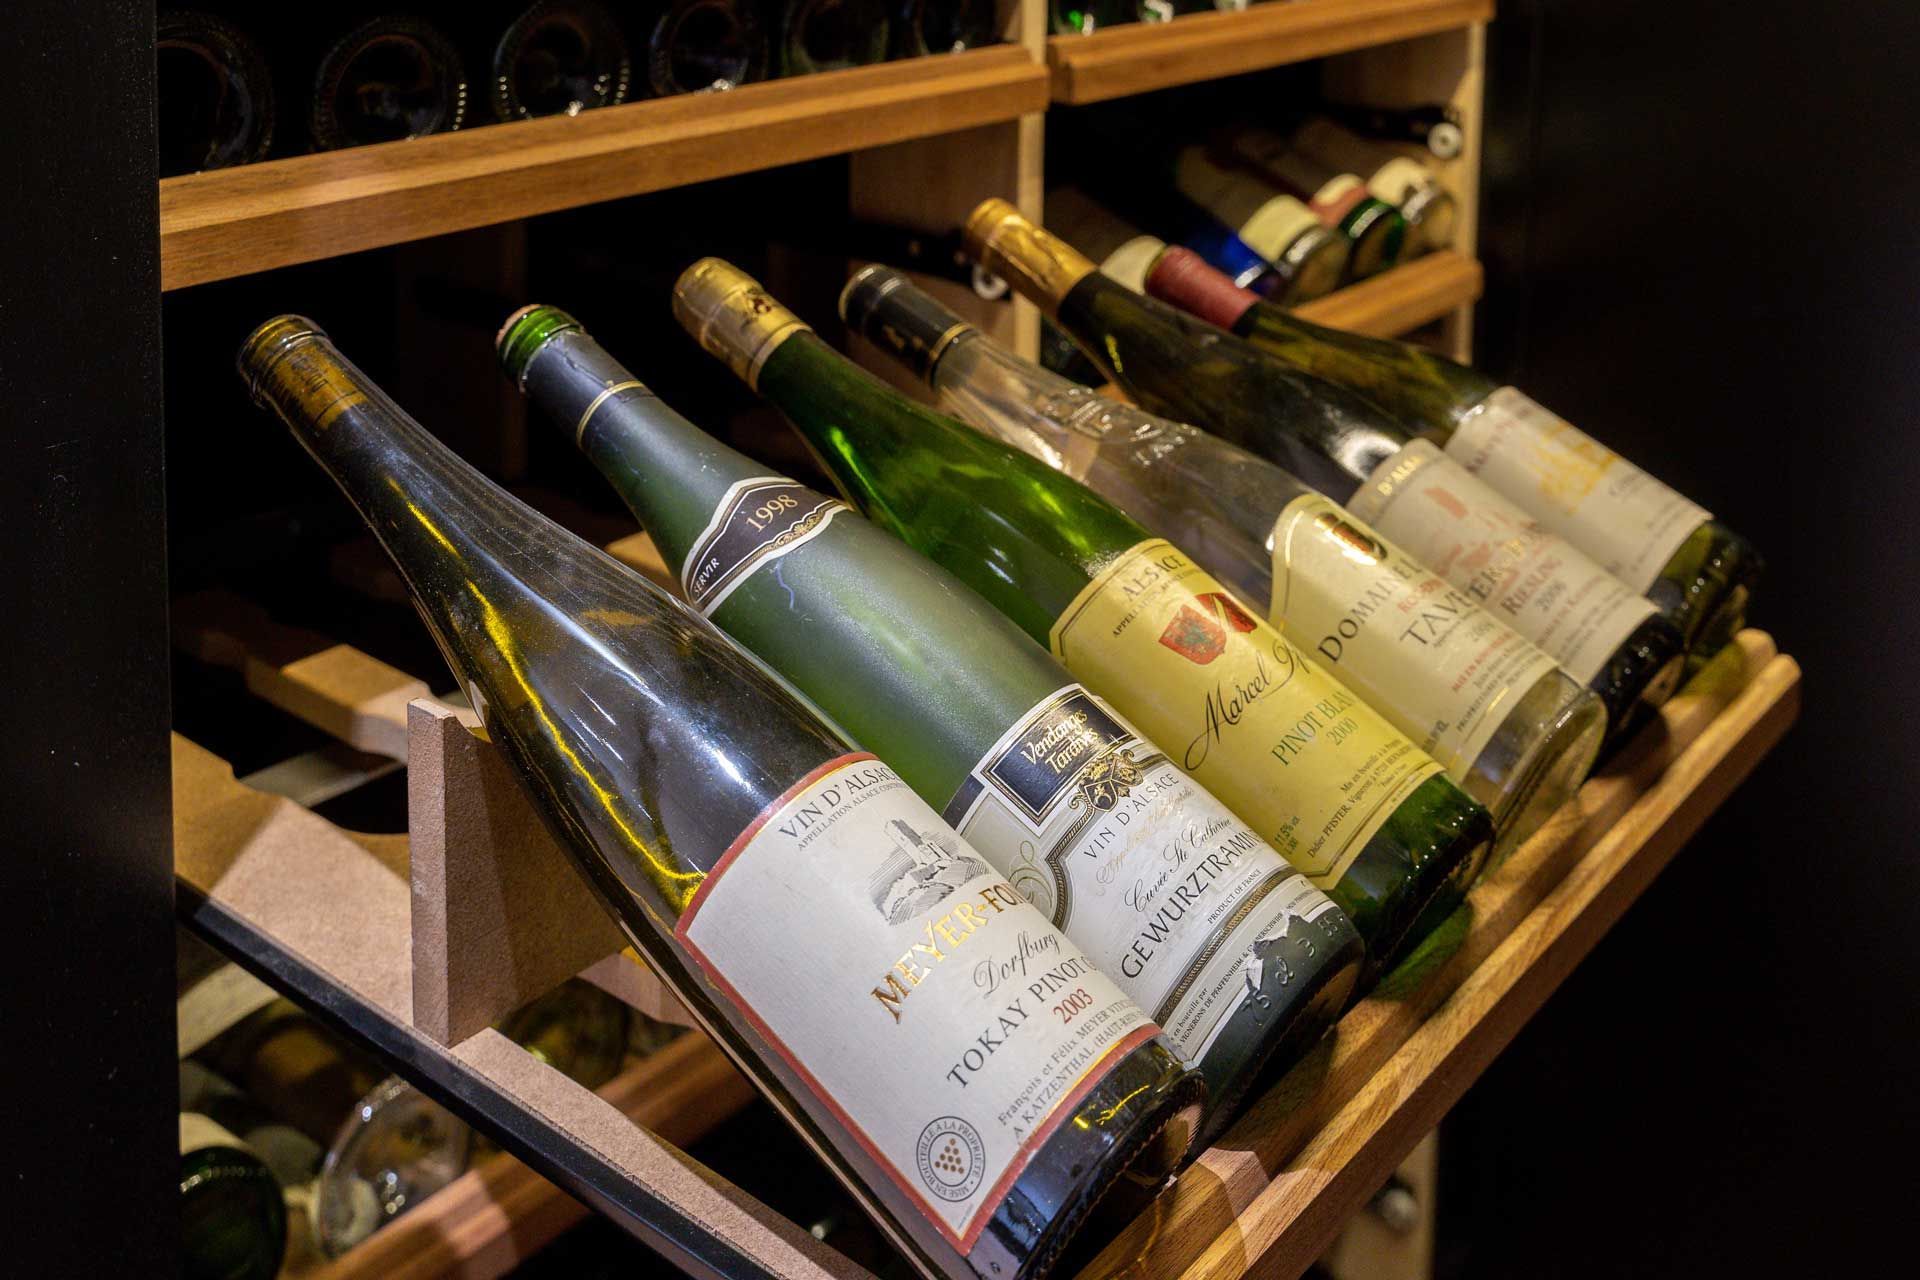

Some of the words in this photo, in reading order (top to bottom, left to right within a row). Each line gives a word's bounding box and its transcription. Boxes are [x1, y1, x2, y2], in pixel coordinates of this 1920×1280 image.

[746, 494, 799, 533] 1998
[1020, 709, 1088, 765] Vendanges
[1185, 651, 1271, 771] Marcel
[1270, 711, 1325, 767] PINOT
[1326, 716, 1359, 746] 2000
[1044, 727, 1100, 775] Tardives
[778, 801, 824, 839] VIN
[797, 803, 854, 851] APPELLATION
[852, 788, 882, 807] ALSACE
[1083, 826, 1116, 860] VIN
[1115, 773, 1180, 827] D'ALSACE
[1307, 836, 1325, 858] Didier
[1121, 830, 1263, 979] GEWURZTRAMIN
[1124, 878, 1169, 912] Cuvée
[1207, 893, 1237, 925] PRODUCT
[1234, 885, 1246, 896] OF
[1242, 868, 1263, 888] FRANCE
[972, 929, 1062, 1000] Dorfburg
[946, 998, 1030, 1089] TOKAY
[1027, 957, 1086, 1004] PINOT
[1052, 988, 1095, 1025] 2003
[1173, 1026, 1181, 1037] en
[1178, 998, 1204, 1028] bouteille
[1198, 987, 1209, 1003] par
[1179, 1003, 1208, 1045] VIGNERONS
[1204, 996, 1214, 1008] DE
[1210, 958, 1247, 999] PFAFFENHEIM
[997, 1076, 1043, 1127] François
[1041, 1063, 1054, 1077] et
[1051, 1039, 1080, 1065] Félix
[1075, 1008, 1113, 1040] MEYER
[1021, 1043, 1097, 1125] KATZENTHAL
[943, 1120, 957, 1130] LA
[934, 1184, 948, 1196] EN
[950, 1186, 970, 1199] MISE
